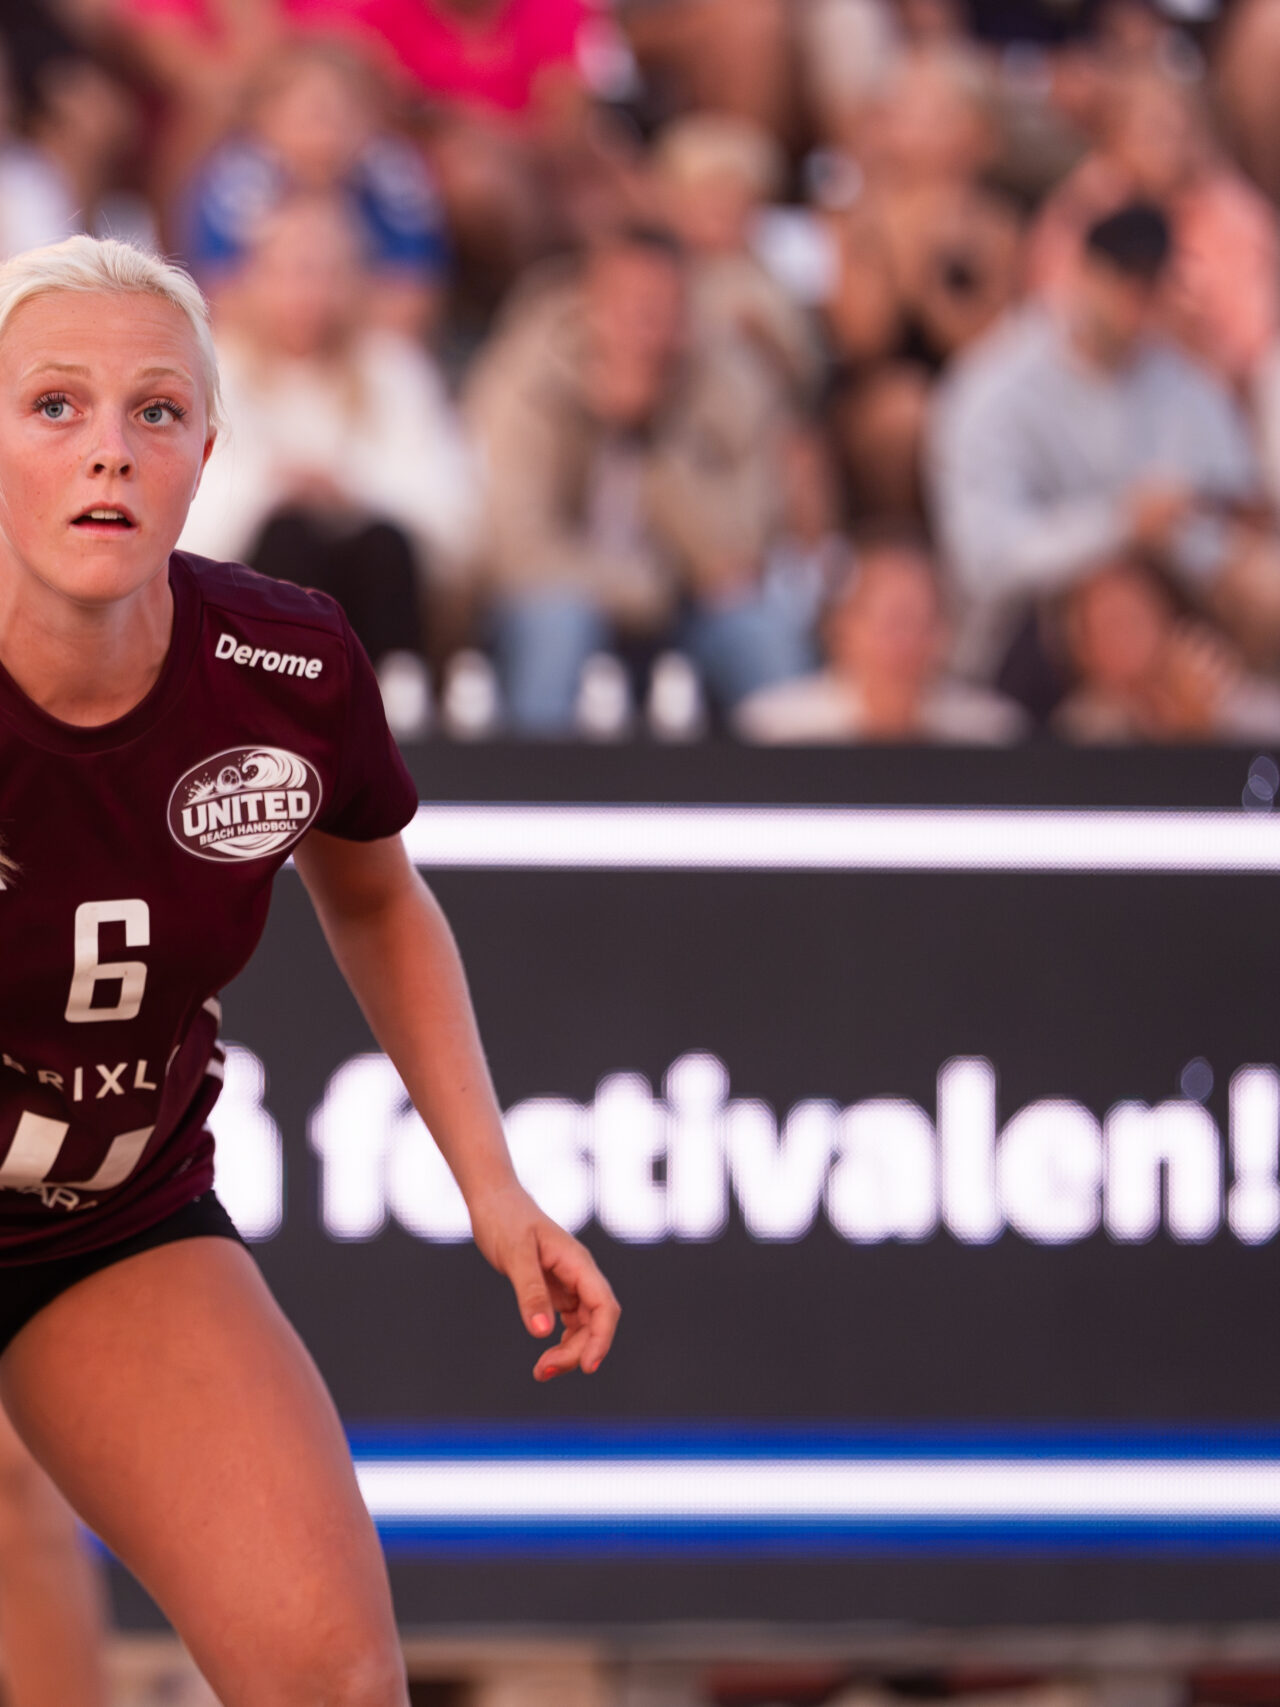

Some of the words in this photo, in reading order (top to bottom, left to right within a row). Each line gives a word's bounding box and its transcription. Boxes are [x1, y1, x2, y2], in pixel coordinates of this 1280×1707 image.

[215, 633, 322, 679] Derome
[181, 789, 311, 837] UNITED
[199, 826, 235, 846] BEACH
[237, 820, 298, 835] HANDBOLL
[64, 899, 150, 1023] 6
